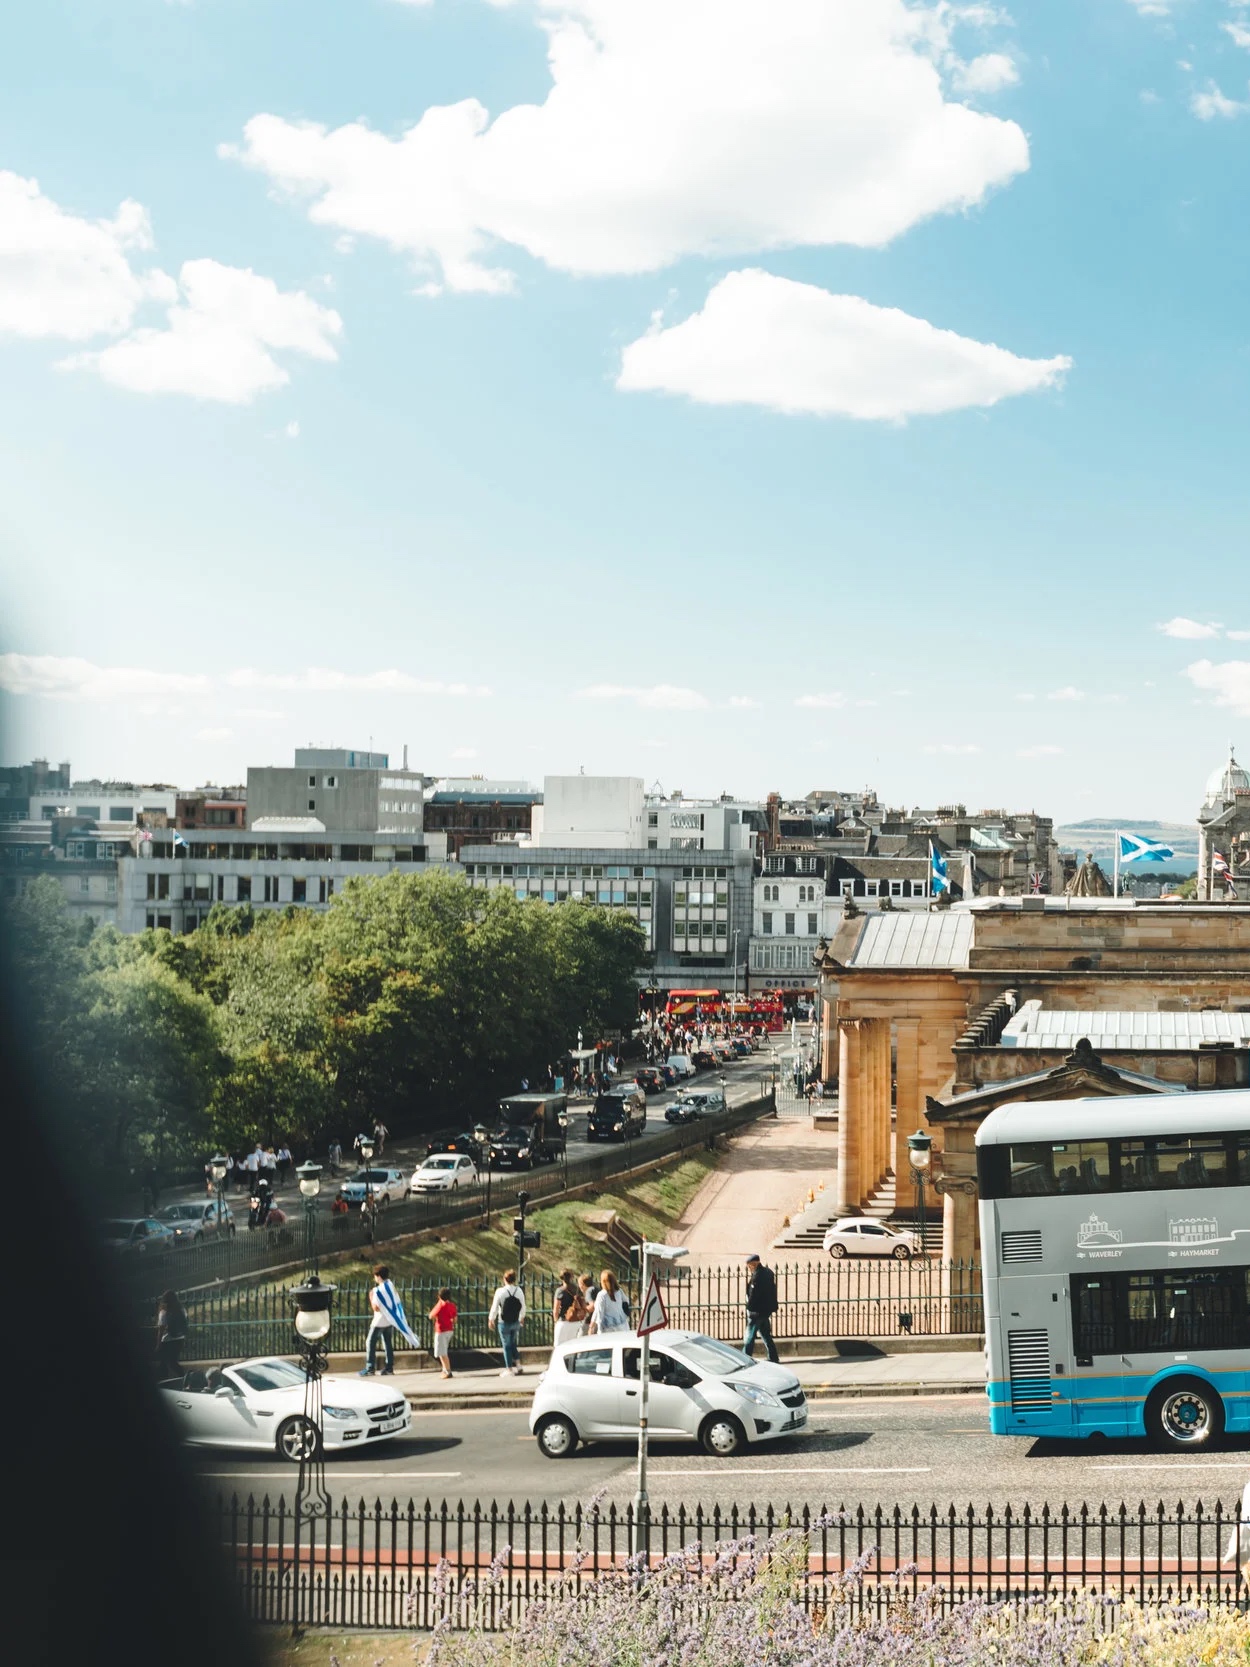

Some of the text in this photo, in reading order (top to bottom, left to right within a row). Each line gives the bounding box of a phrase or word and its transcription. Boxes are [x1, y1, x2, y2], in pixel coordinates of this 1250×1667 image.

[765, 980, 805, 988] OFFICE
[1089, 1250, 1123, 1258] WAVERLEY
[1180, 1249, 1219, 1257] HAYMARKET
